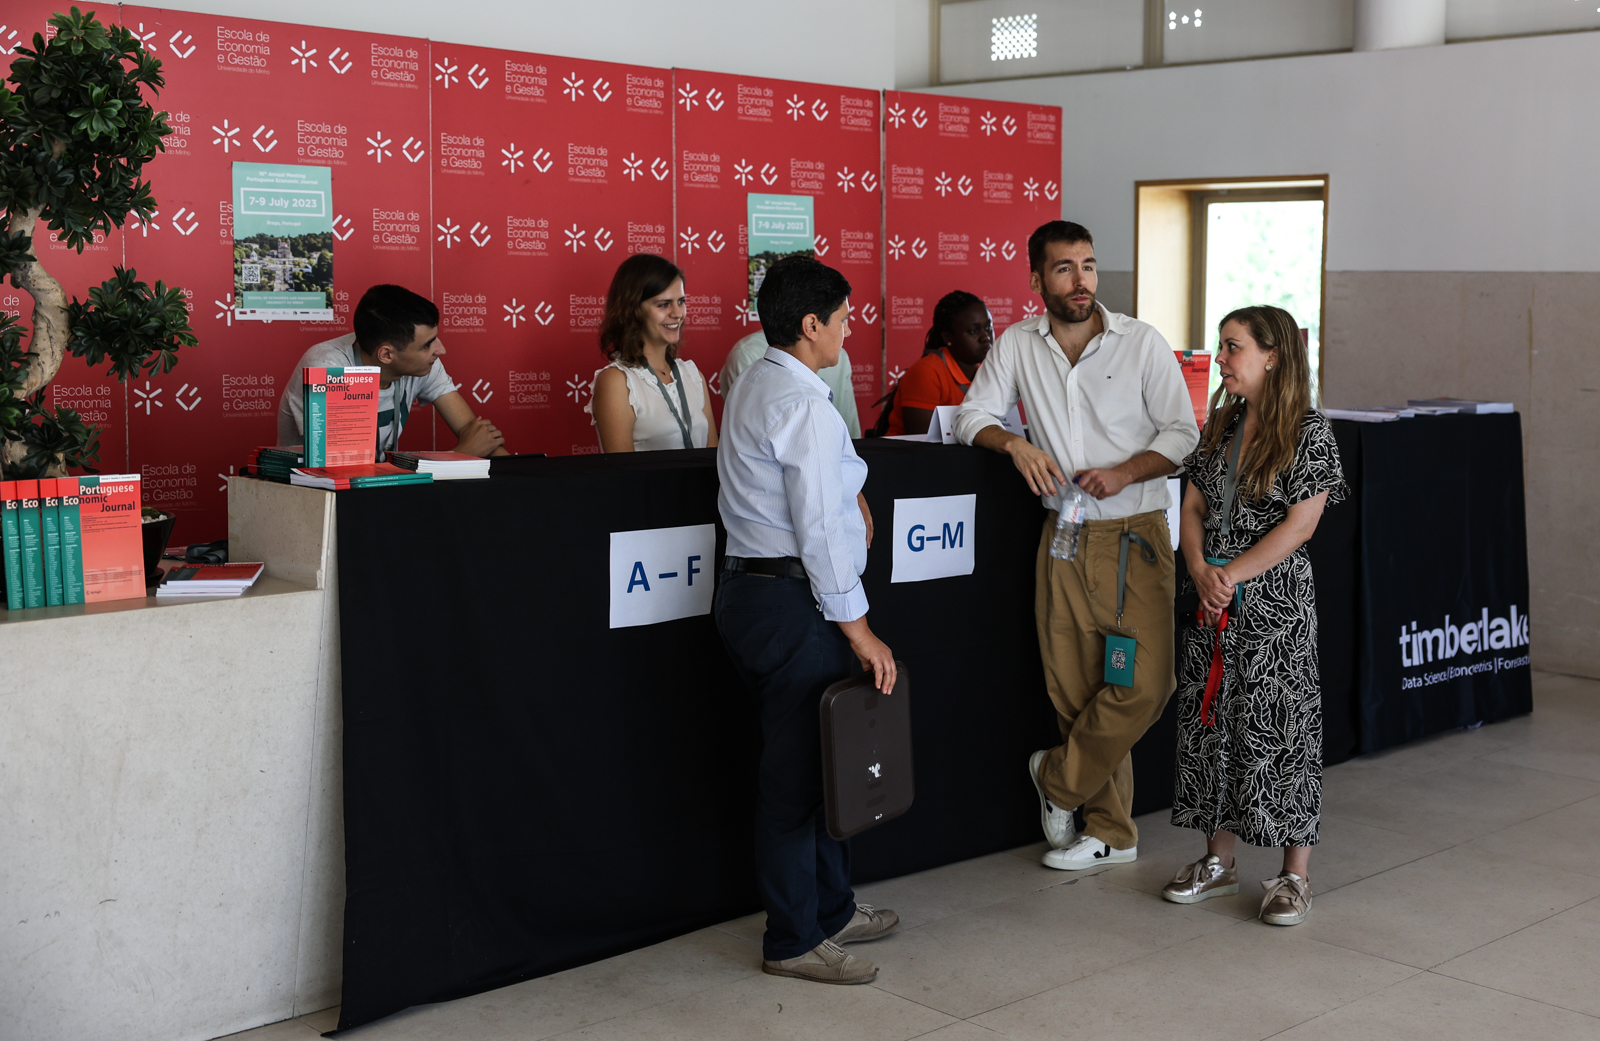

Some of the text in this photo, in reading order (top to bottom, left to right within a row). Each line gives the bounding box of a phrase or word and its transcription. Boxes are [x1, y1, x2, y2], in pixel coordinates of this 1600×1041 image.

[217, 26, 270, 43] Escola de
[217, 39, 270, 55] Economia
[371, 43, 418, 59] Escola de
[217, 52, 266, 67] e Gestão
[371, 55, 418, 71] Economia
[505, 60, 547, 75] Escola de
[371, 68, 415, 82] e Gestão
[505, 71, 547, 86] Economia
[626, 74, 664, 88] Escola de
[505, 83, 544, 96] e Gestão
[627, 84, 664, 98] Economia
[626, 96, 661, 108] e Gestão
[297, 120, 347, 135] Escola de
[298, 132, 348, 147] Economia
[441, 132, 484, 146] Escola de
[297, 145, 344, 158] e Gestão
[441, 144, 485, 158] Economia
[568, 143, 608, 156] Escola de
[683, 150, 720, 162] Escola de
[441, 156, 482, 169] e Gestão
[568, 154, 608, 167] Economia
[684, 161, 720, 173] Economia
[568, 166, 605, 177] e Gestão
[690, 172, 718, 183] Gestão
[249, 197, 317, 208] 7-9 July 2023
[373, 208, 420, 221] Escola de
[373, 220, 420, 233] Economia
[507, 216, 548, 228] Escola de
[771, 222, 785, 230] July
[373, 232, 416, 244] e Gestão
[507, 227, 549, 239] Economia
[507, 238, 546, 250] e Gestão
[443, 292, 486, 304] Escola de
[443, 304, 487, 315] Economia
[443, 315, 484, 326] e Gestão
[1182, 355, 1209, 363] Portuguese
[222, 374, 274, 386] Escola de
[327, 375, 373, 385] Portuguese
[509, 370, 550, 381] Escola de
[53, 384, 111, 397] Escola de
[223, 386, 275, 398] Economia
[313, 384, 350, 392] Economic
[509, 381, 551, 392] Economia
[344, 392, 373, 400] Journal
[509, 393, 548, 404] e Gestão
[54, 397, 112, 410] Economia
[222, 399, 271, 411] e Gestão
[142, 463, 196, 476] Escola de
[142, 475, 197, 489] Economia
[80, 484, 134, 495] Portuguese
[142, 488, 193, 502] e Gestão
[63, 494, 108, 505] Economic
[101, 501, 136, 512] Journal
[627, 560, 650, 593] A
[688, 555, 701, 586] F
[1399, 605, 1529, 668] timberlake
[1402, 677, 1422, 690] Data
